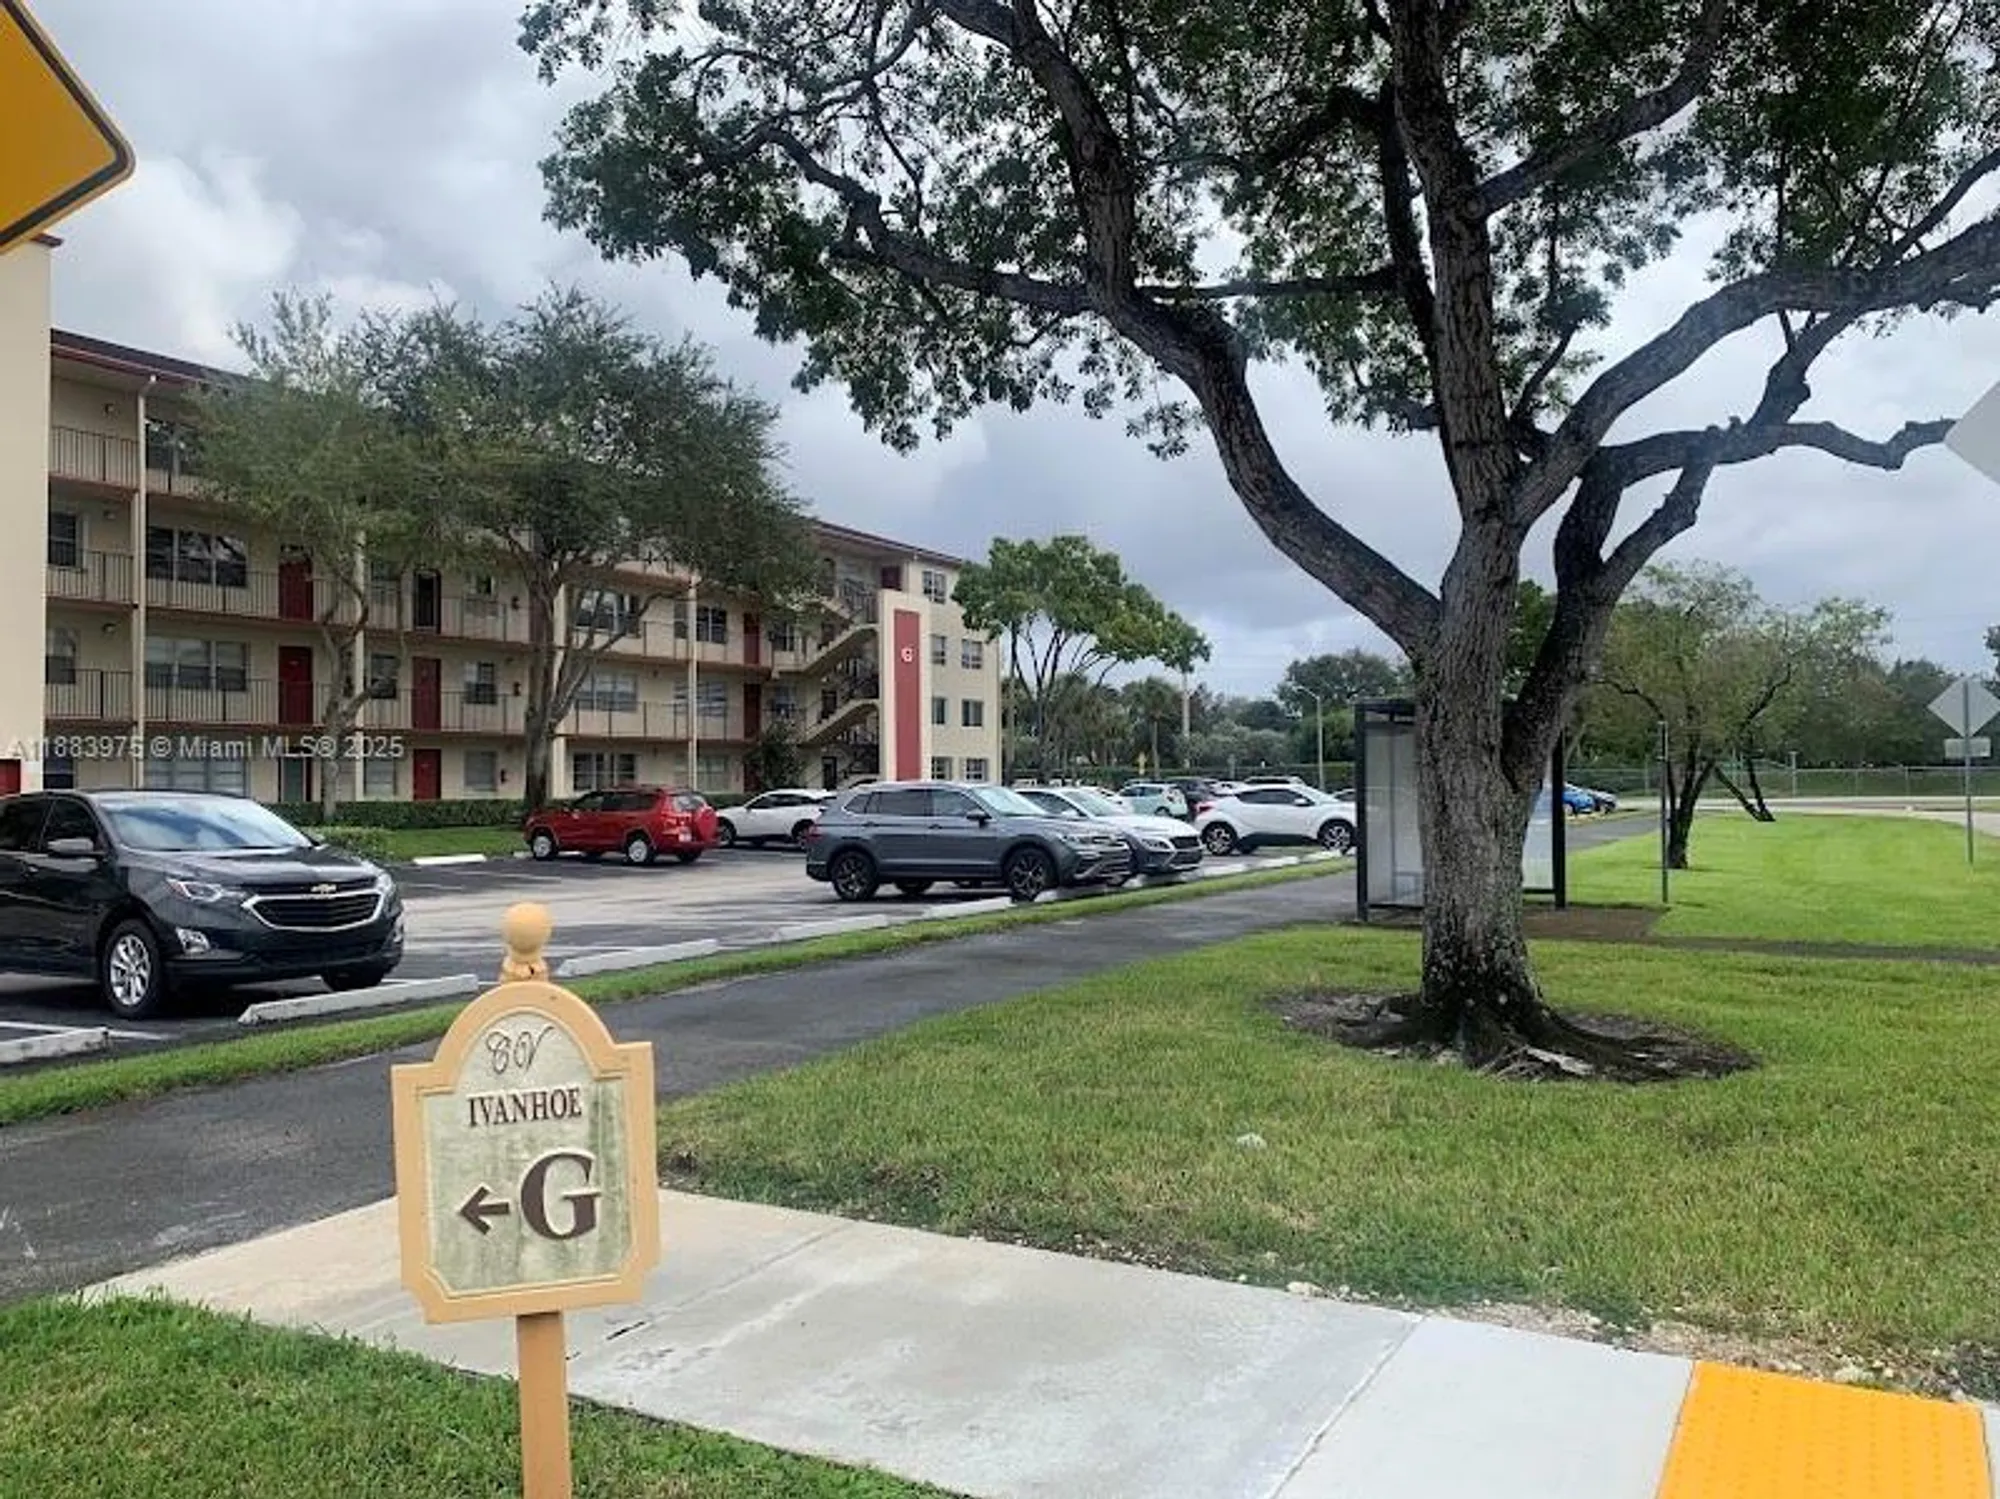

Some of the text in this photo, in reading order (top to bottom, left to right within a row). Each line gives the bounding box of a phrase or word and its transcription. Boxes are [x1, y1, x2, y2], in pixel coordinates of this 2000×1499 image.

[901, 648, 912, 662] G
[468, 1087, 581, 1126] IVANHOE
[520, 1150, 602, 1240] G
